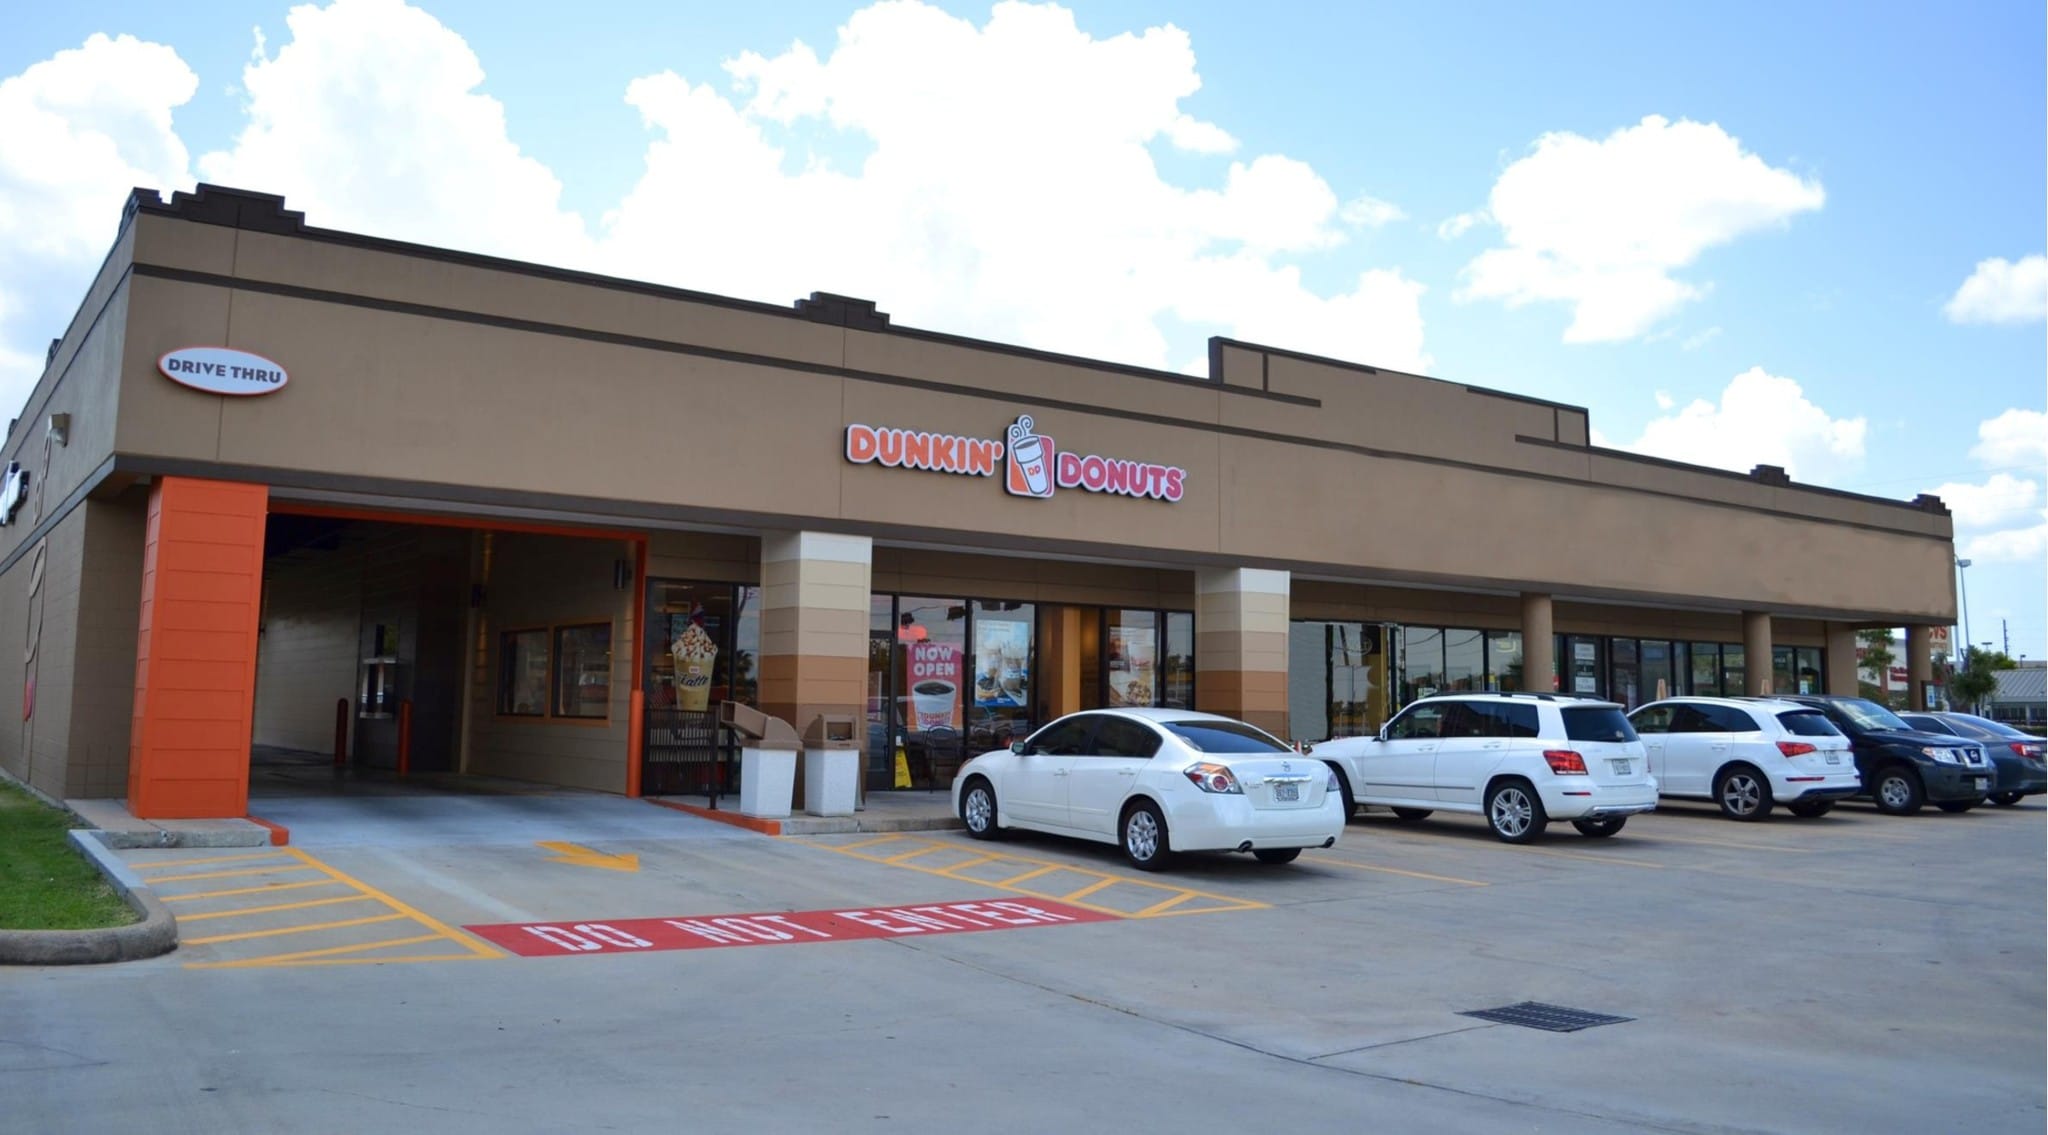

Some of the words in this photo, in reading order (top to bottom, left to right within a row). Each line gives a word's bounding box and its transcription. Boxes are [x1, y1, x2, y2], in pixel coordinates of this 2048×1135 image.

[167, 358, 227, 377] DRIVE
[230, 365, 282, 384] THRU
[848, 425, 1003, 475] DUNKIN'
[1059, 453, 1184, 500] DONUTS
[914, 646, 953, 661] NOW
[913, 662, 955, 676] OPEN
[521, 923, 654, 951] DO
[663, 915, 832, 944] NOT
[834, 902, 1077, 933] ENTER
